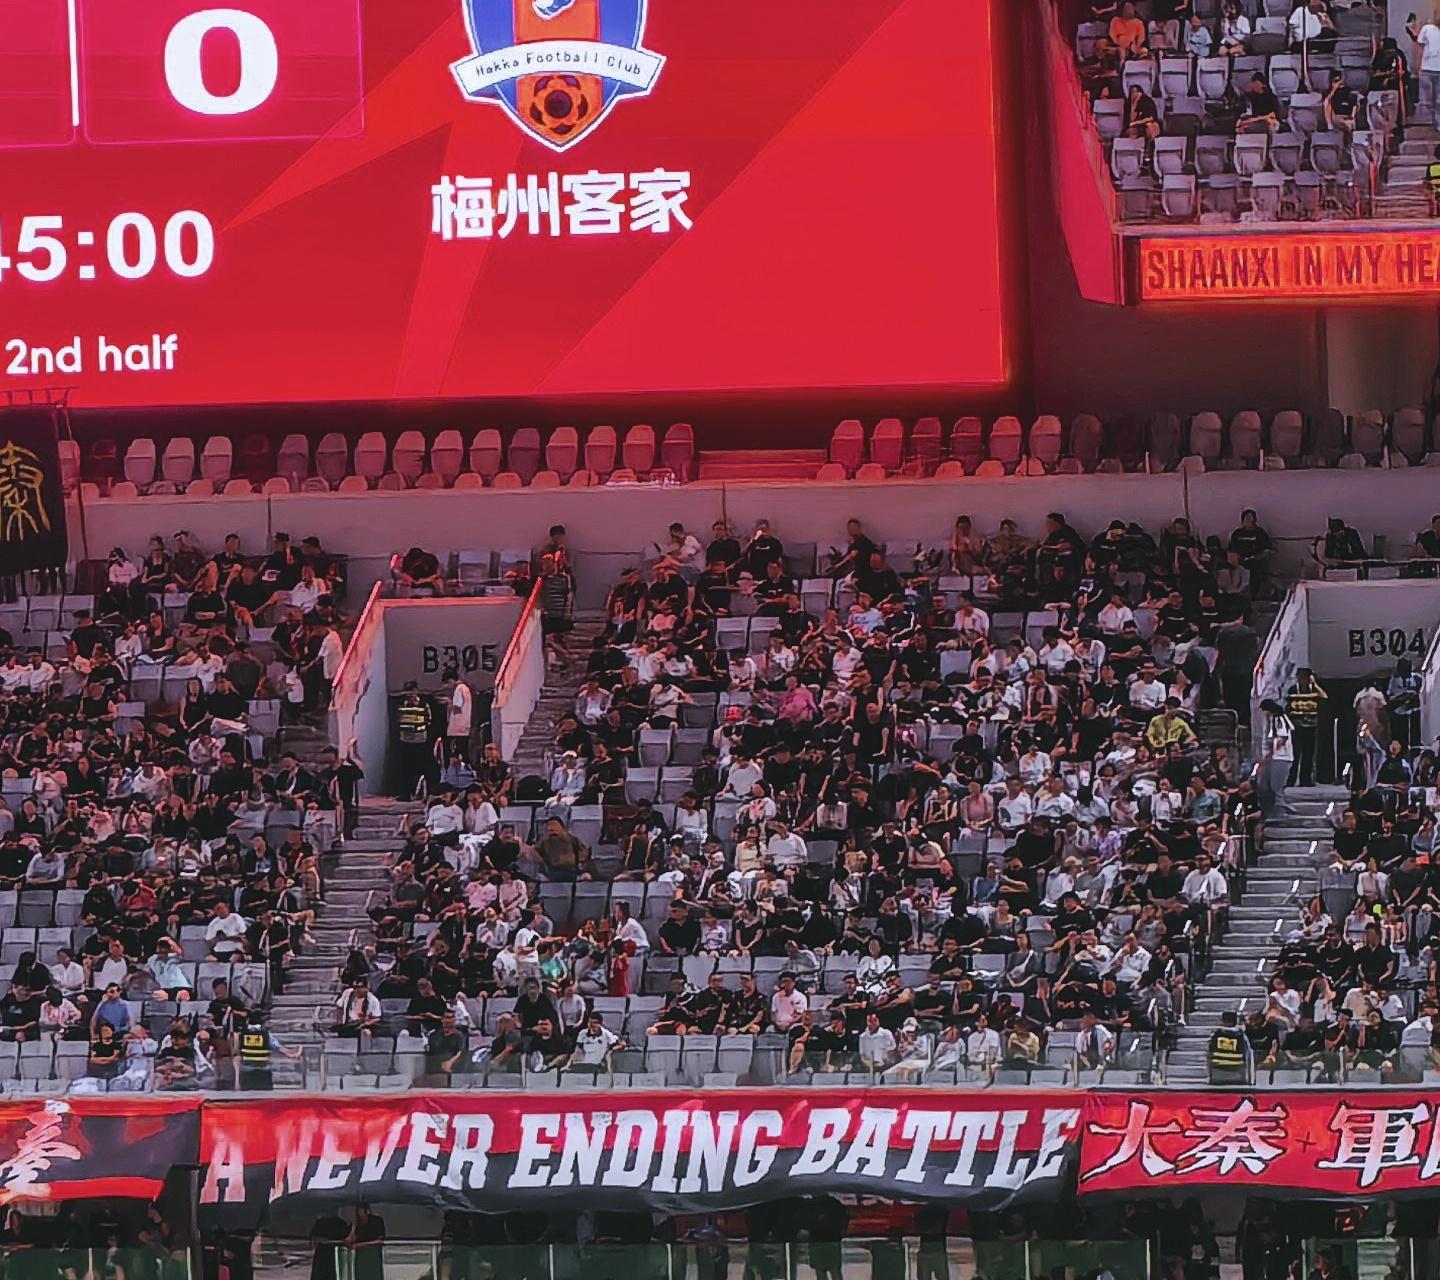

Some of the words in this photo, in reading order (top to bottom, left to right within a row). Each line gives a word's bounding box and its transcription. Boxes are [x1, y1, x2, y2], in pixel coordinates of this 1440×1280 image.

[164, 9, 278, 115] 0
[526, 51, 598, 66] Football
[607, 55, 641, 76] Club
[430, 167, 693, 241] 梅州客家
[1148, 241, 1282, 290] SHAANXI
[1293, 241, 1323, 286] IN
[1334, 241, 1384, 285] MY
[5, 336, 82, 376] 2nd
[98, 333, 179, 372] half
[199, 1120, 248, 1205] A
[269, 1111, 493, 1205] NEVER
[506, 1106, 785, 1194] ENDING
[790, 1104, 1079, 1191] BATTLE
